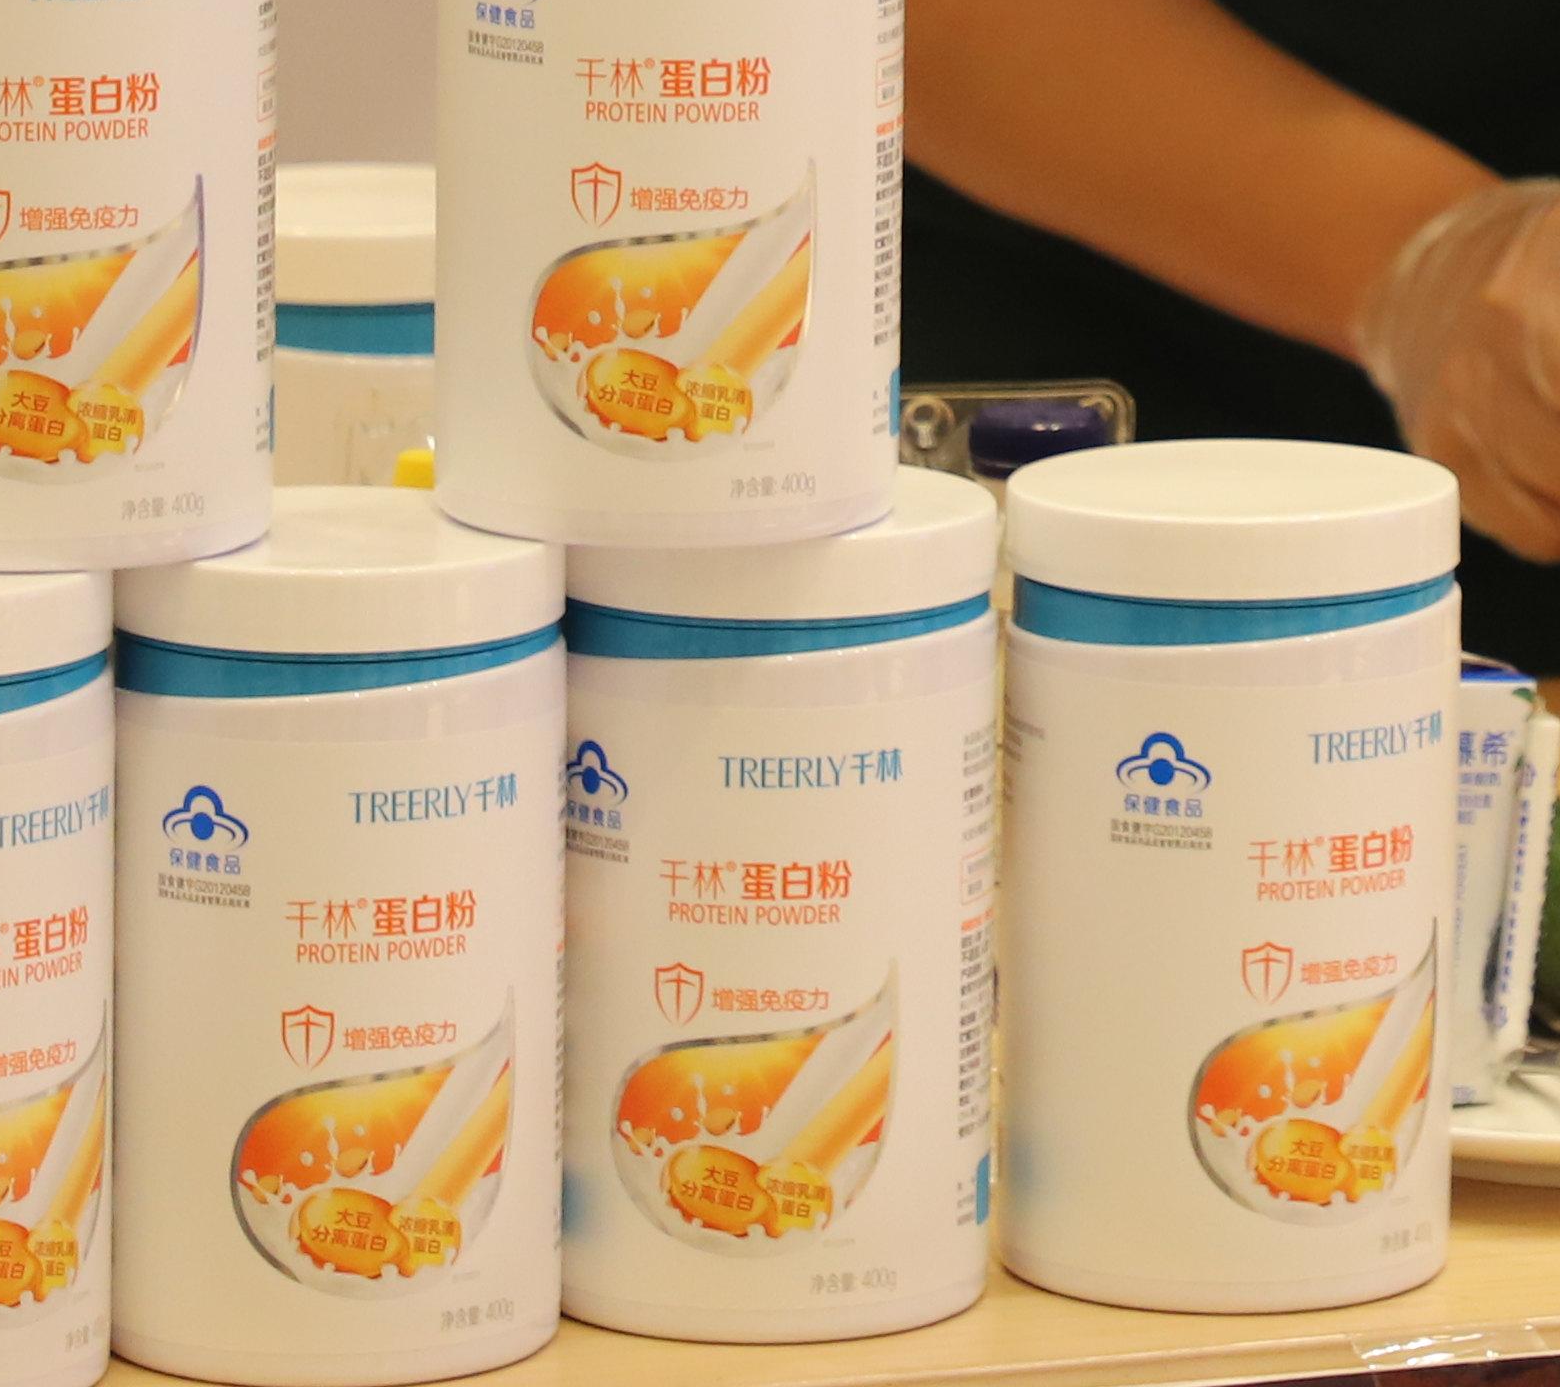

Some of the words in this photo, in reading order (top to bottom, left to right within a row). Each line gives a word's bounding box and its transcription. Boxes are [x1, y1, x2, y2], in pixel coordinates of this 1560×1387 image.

[475, 1, 535, 29] 保健食品
[584, 101, 668, 124] PROTEIN
[674, 101, 761, 123] POWDER
[63, 117, 149, 141] POWDER
[630, 185, 749, 212] 增强免疫力
[18, 203, 140, 231] 增强免疫力
[621, 369, 659, 391] 大豆
[11, 391, 51, 413] 大豆
[597, 383, 674, 416] 分离蛋白
[700, 401, 731, 422] 蛋白
[730, 476, 777, 499] 净含量:
[781, 472, 816, 497] 400g
[171, 491, 205, 518] 400g
[1124, 793, 1204, 818] 保健食品
[169, 846, 242, 876] 保健食品
[1255, 874, 1335, 903] PROTEIN
[1339, 868, 1407, 898] POWDER
[668, 901, 749, 926] PROTEIN
[754, 901, 841, 925] POWDER
[295, 940, 380, 965] PROTEIN
[386, 935, 467, 963] POWDER
[24, 949, 83, 985] POWDER
[1299, 952, 1399, 987] 增强免疫力
[711, 987, 830, 1013] 增强免疫力
[342, 1020, 458, 1052] 增强免疫力
[1290, 1139, 1324, 1158] 大豆
[702, 1165, 740, 1188] 大豆
[1267, 1157, 1337, 1180] 分离蛋白
[680, 1179, 754, 1213] 分离蛋白
[334, 1208, 373, 1230] 大豆
[310, 1224, 388, 1252] 分离蛋白
[860, 1266, 897, 1293] 400g
